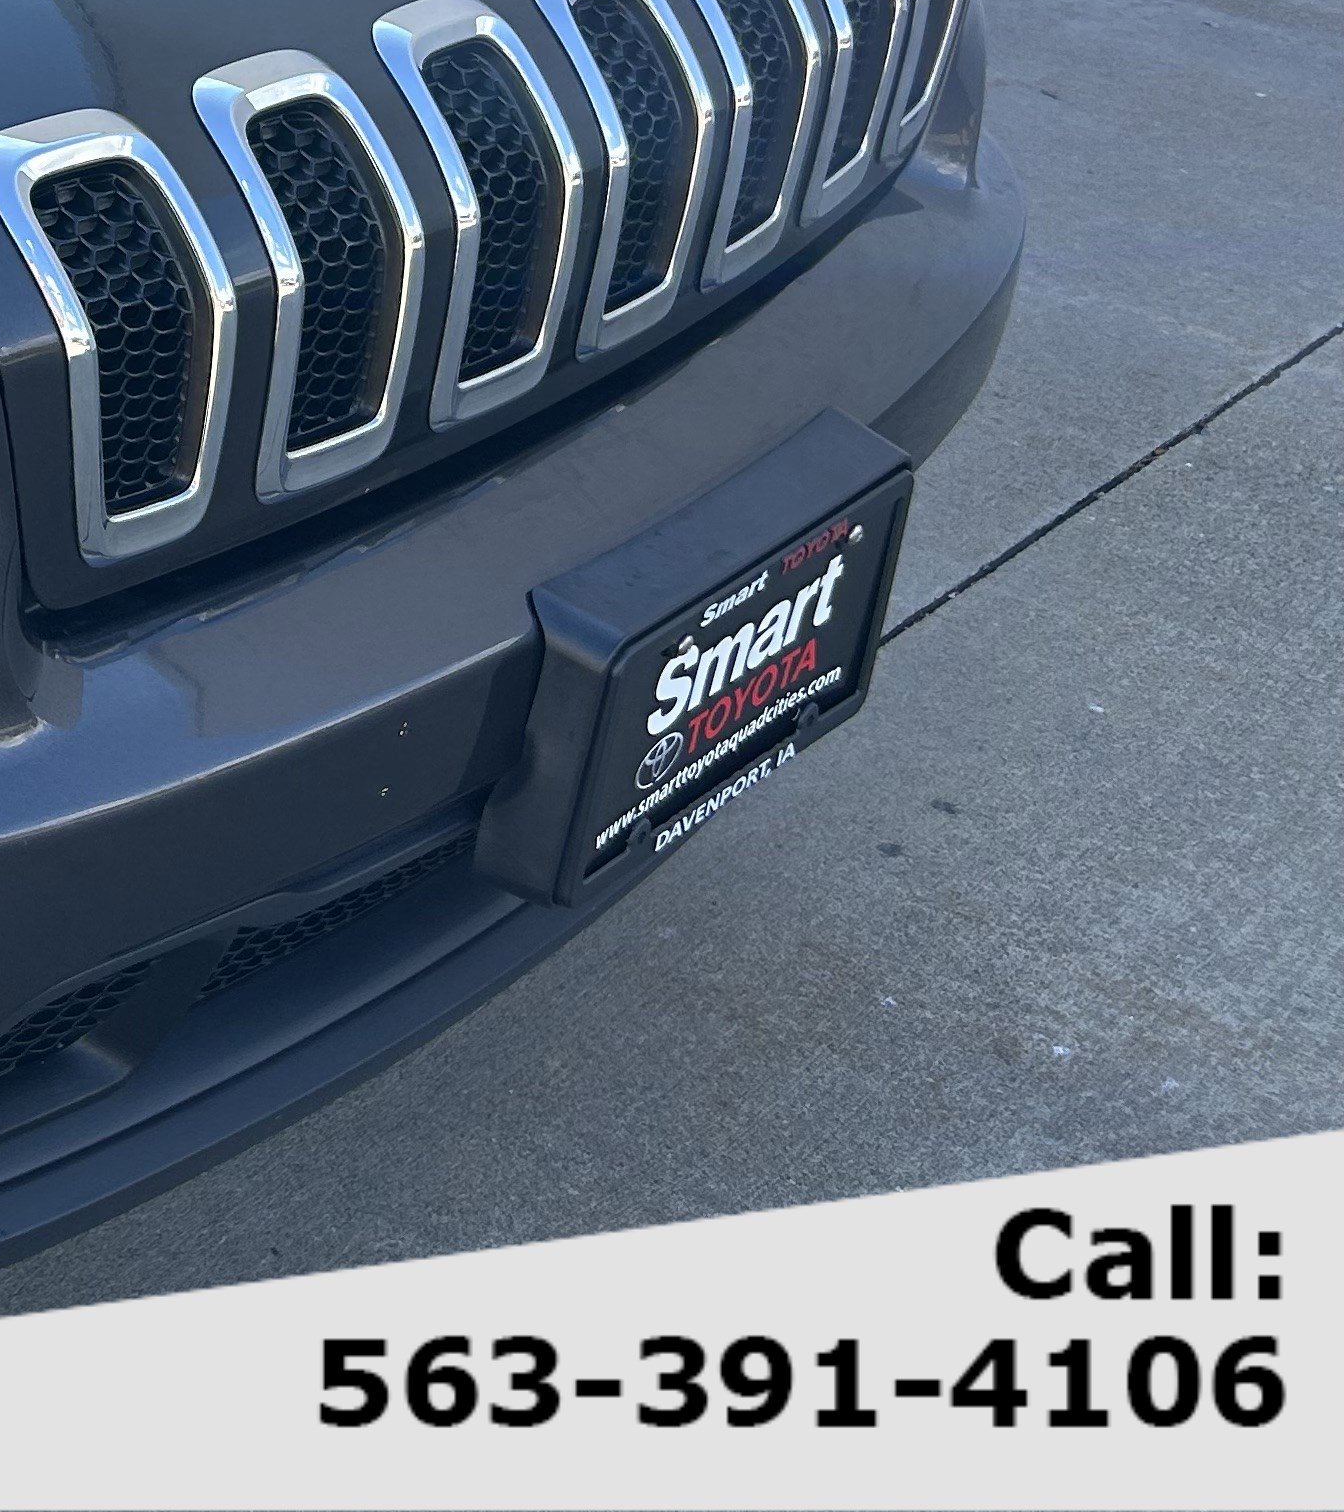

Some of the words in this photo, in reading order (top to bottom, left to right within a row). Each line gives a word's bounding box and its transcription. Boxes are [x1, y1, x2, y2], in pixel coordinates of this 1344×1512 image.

[700, 570, 769, 628] Smart
[781, 518, 849, 575] TOYOTA
[647, 554, 844, 735] Smart
[688, 638, 817, 754] TOYOTA
[596, 666, 842, 850] www.smarttoyotaquadcities.com
[654, 758, 772, 852] DAVENPORT,
[776, 742, 797, 767] IA
